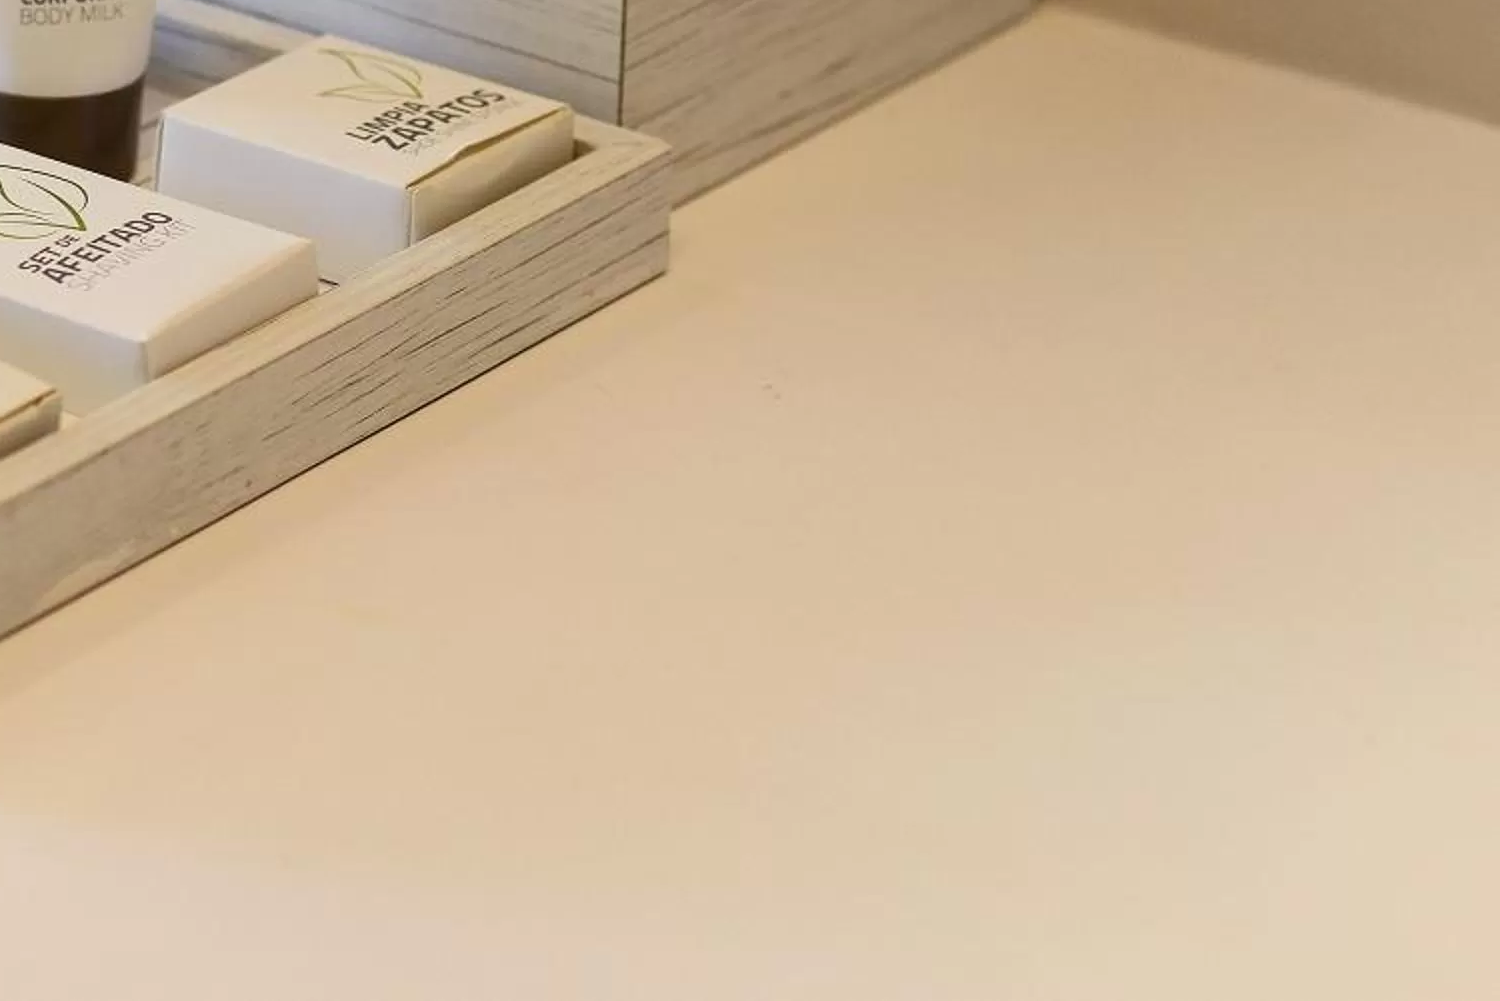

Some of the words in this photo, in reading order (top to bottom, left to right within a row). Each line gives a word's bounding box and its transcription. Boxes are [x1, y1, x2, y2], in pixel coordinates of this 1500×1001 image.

[20, 6, 73, 26] BODY
[80, 3, 123, 23] MILK
[345, 101, 429, 140] LIMPIA
[371, 89, 506, 150] ZAPATOS
[19, 246, 61, 273] SET
[42, 212, 173, 284] AFEITADO
